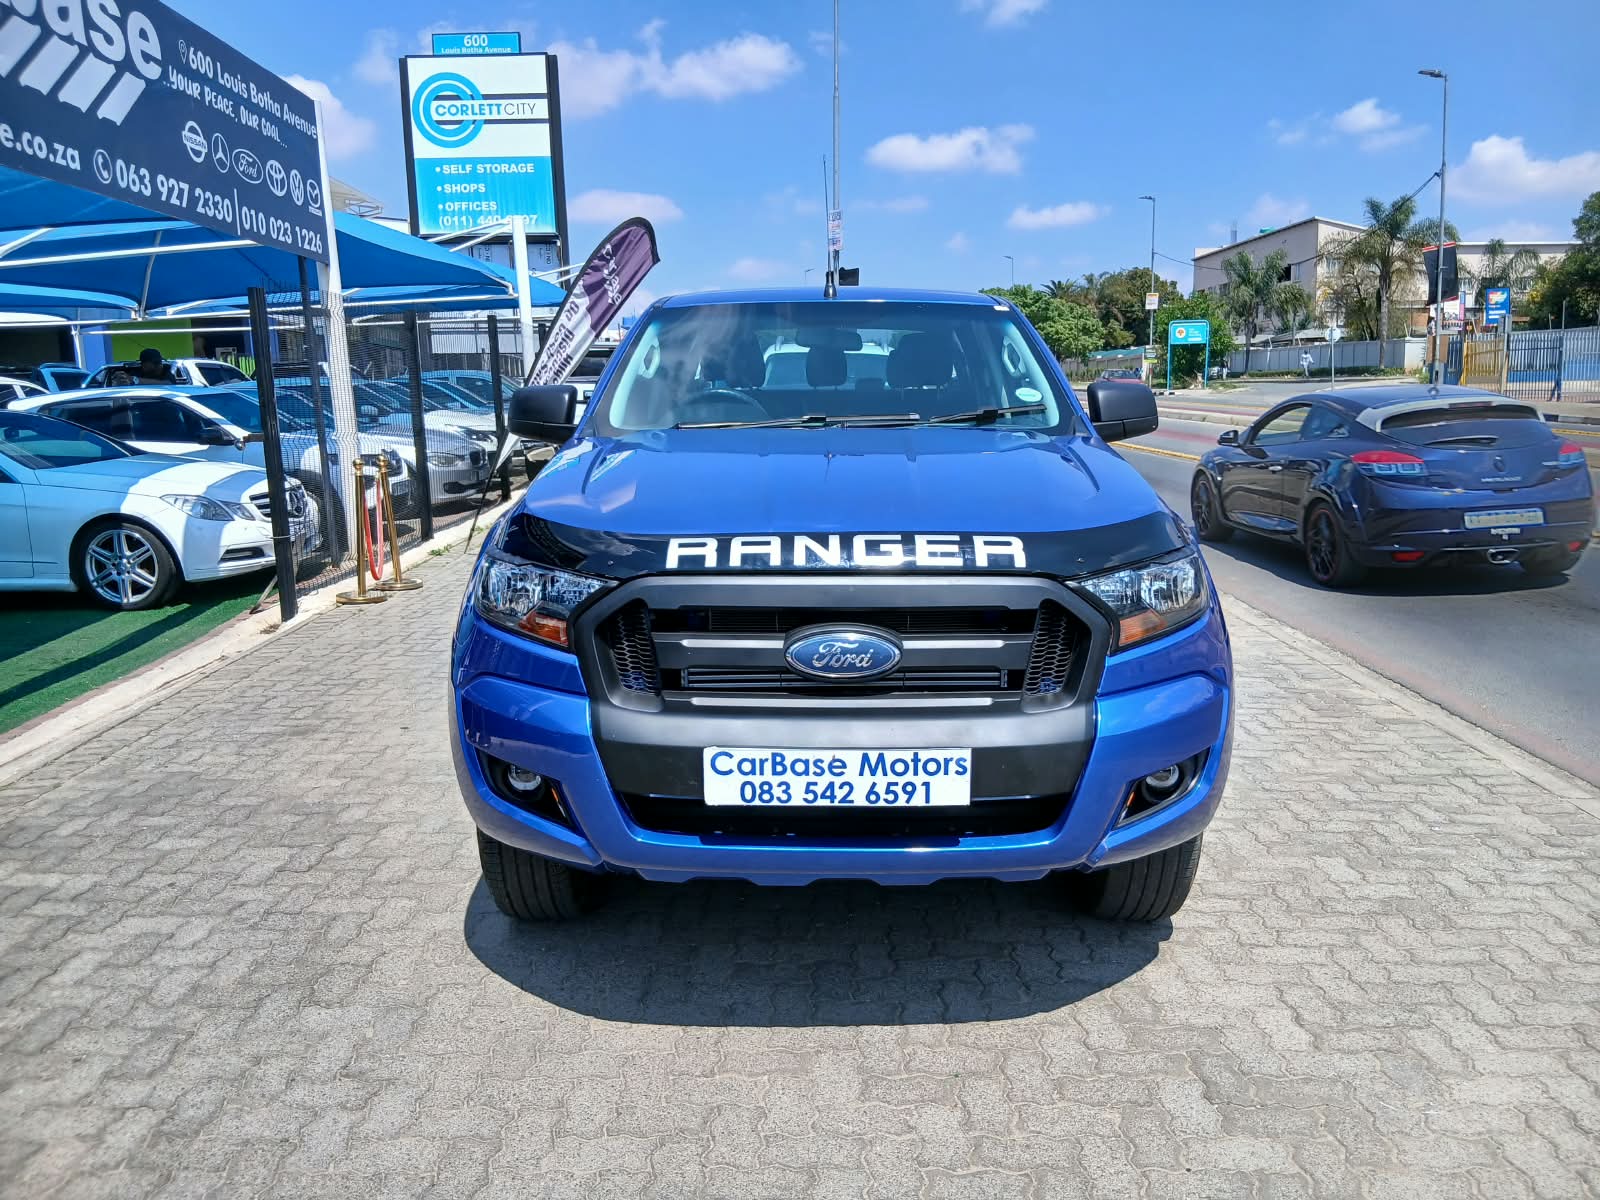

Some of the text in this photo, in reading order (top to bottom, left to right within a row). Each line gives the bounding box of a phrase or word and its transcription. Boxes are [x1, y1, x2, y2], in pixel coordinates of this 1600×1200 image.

[464, 34, 489, 47] 600
[188, 47, 318, 139] 600 Louis Botha Avenue
[434, 102, 537, 117] CORLETT CITY
[442, 163, 535, 174] SELF STORAGE
[443, 183, 486, 193] SHOPS
[115, 158, 323, 254] 063 927 2330 010 023 1226
[445, 201, 497, 211] OFFICES
[439, 215, 473, 230] (011)
[665, 534, 1026, 569] RANGER
[811, 641, 874, 668] Ford
[709, 751, 968, 778] CarBase Motors
[739, 780, 931, 805] 083 542 6591
